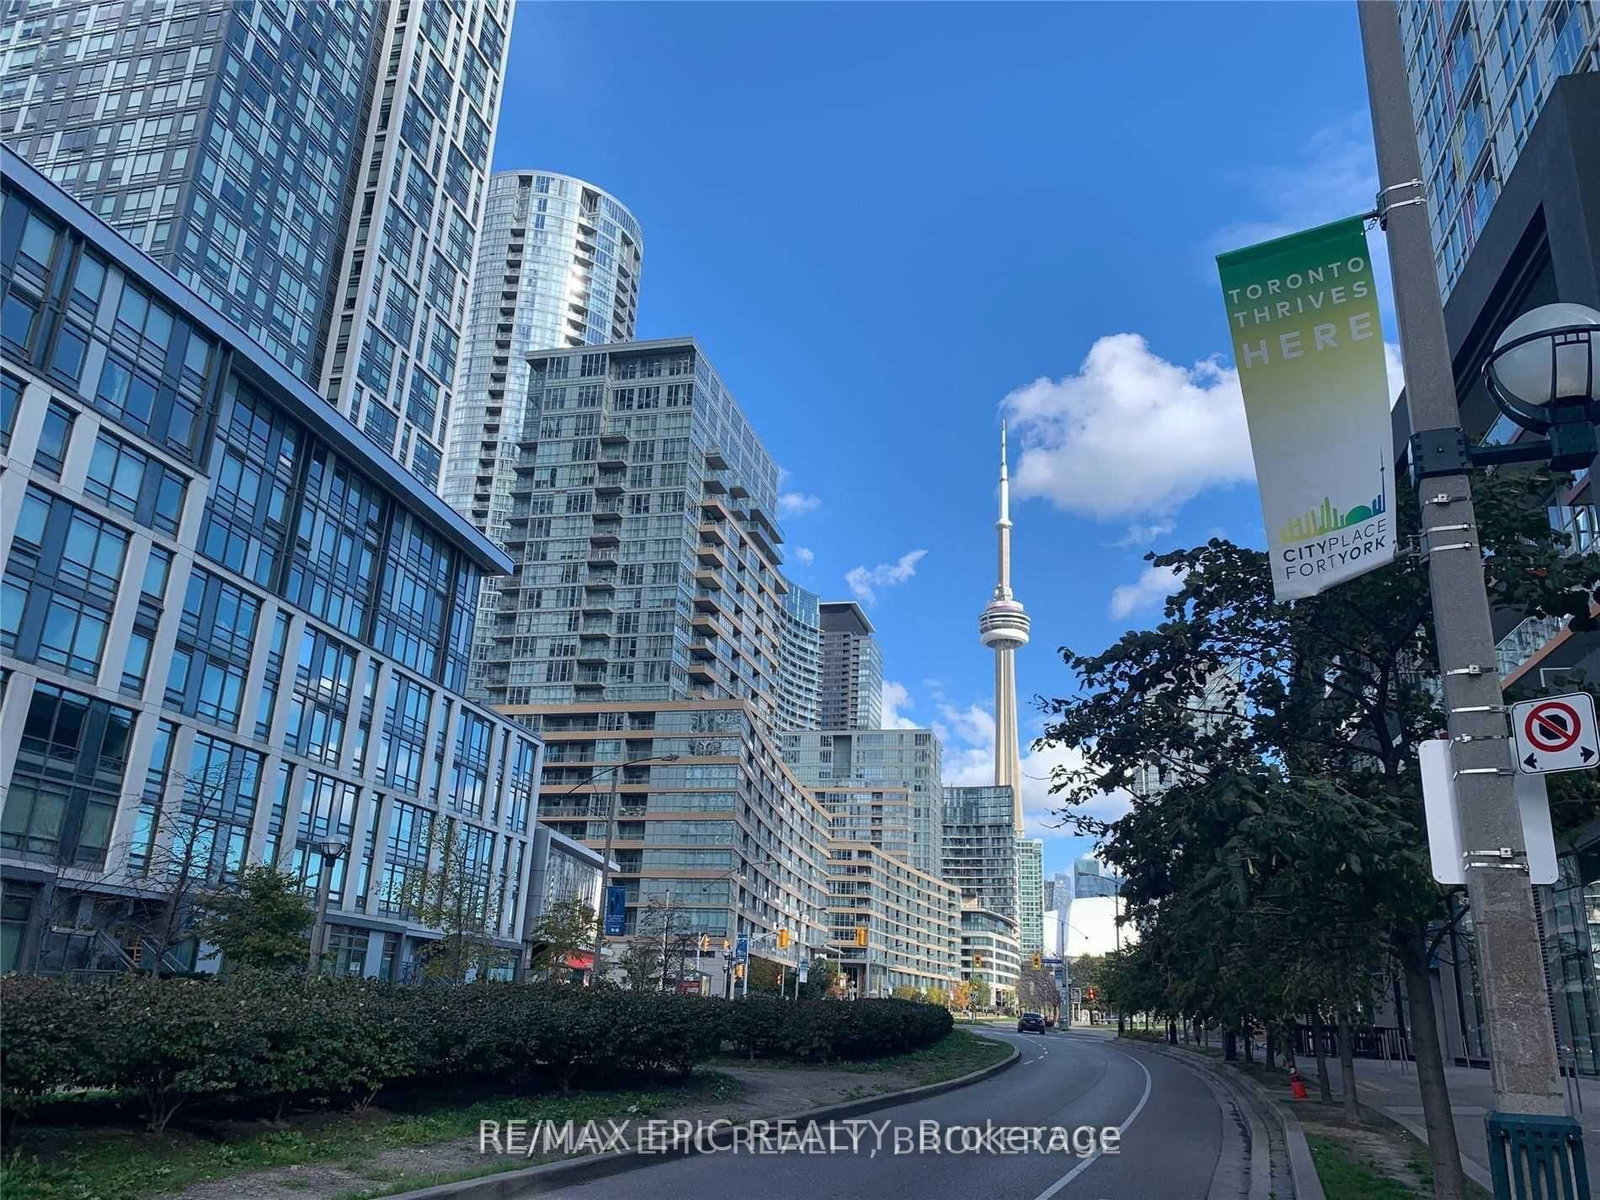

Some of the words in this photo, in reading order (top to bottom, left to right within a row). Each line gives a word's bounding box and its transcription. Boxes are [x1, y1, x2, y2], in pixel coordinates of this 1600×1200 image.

[1228, 257, 1364, 304] TORONTO
[1234, 281, 1368, 328] THRIVES
[1242, 312, 1373, 368] HERE
[1283, 518, 1386, 562] CITYPLACE
[1286, 535, 1385, 580] FORTYORK
